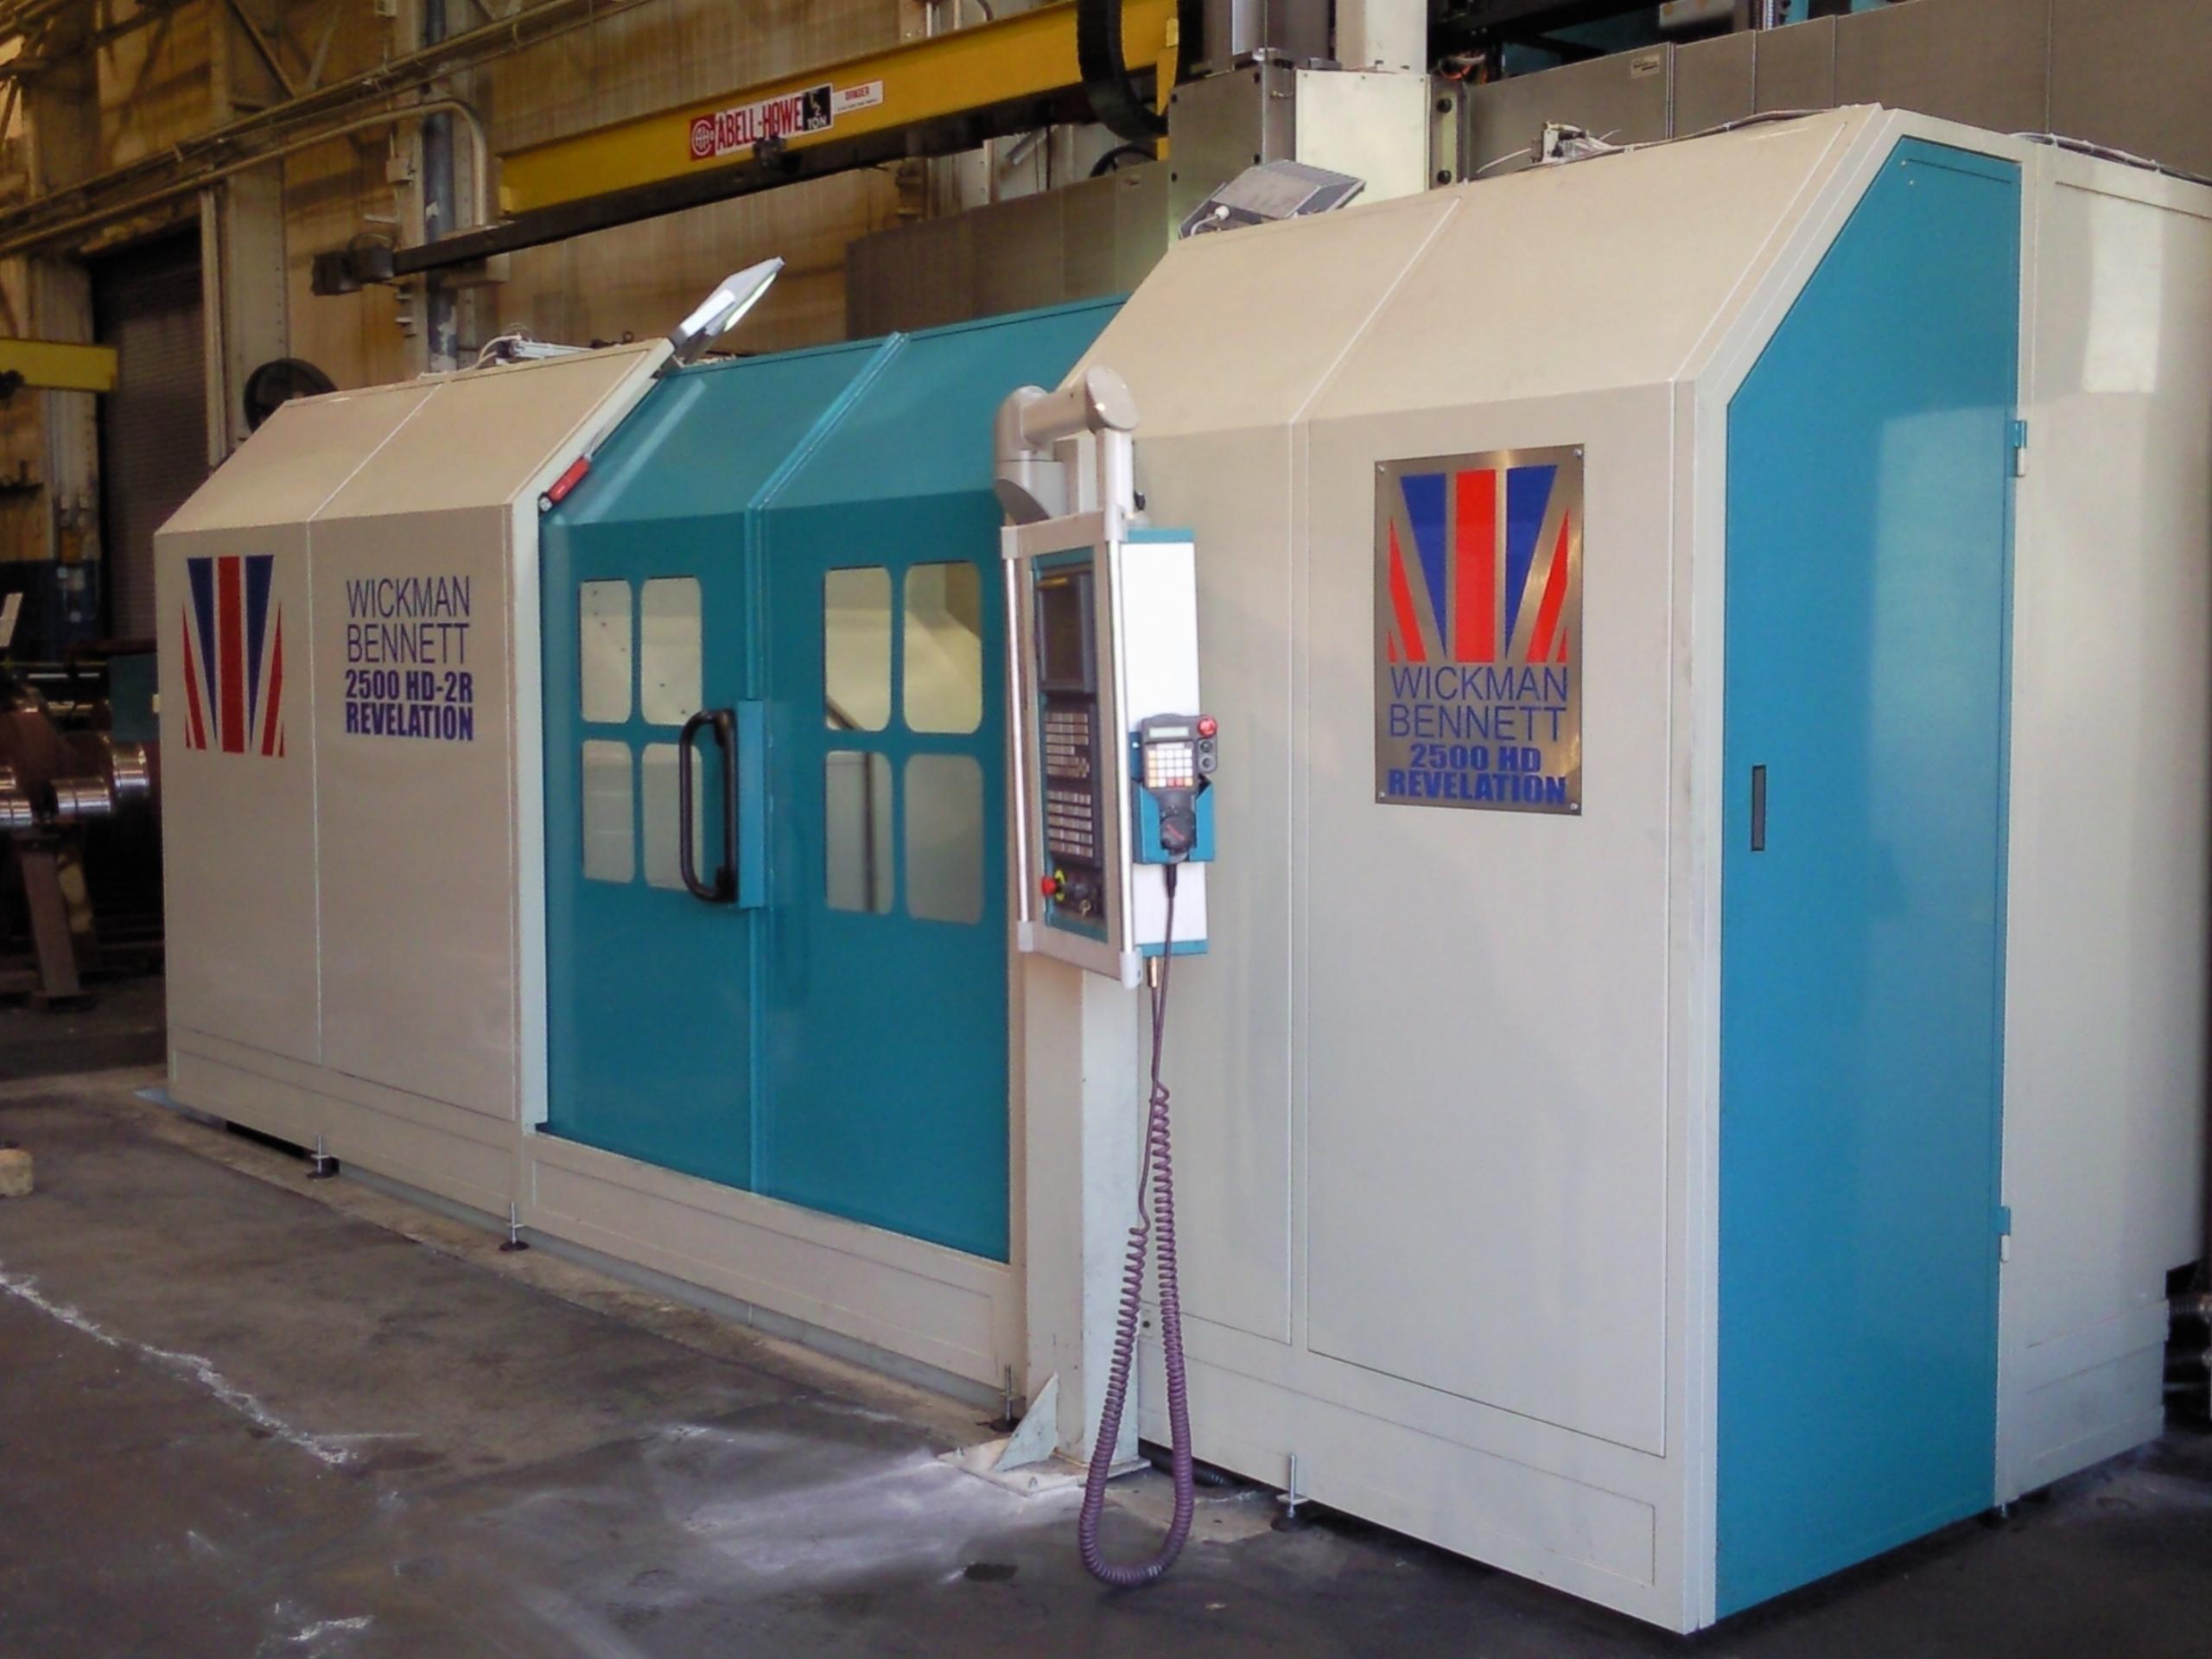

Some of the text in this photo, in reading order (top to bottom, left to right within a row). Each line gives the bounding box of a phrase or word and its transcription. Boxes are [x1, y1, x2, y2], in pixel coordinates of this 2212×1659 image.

[716, 97, 803, 151] ABELL-HOWE
[807, 116, 827, 130] TON
[346, 575, 469, 618] WICKMAN
[347, 623, 469, 664] BENNETT
[346, 669, 473, 702] 2500 HD-2R
[1390, 666, 1567, 702] WICKMAN
[346, 702, 473, 741] REVELATION
[1389, 703, 1567, 741] BENNETT
[1410, 743, 1541, 772] 2500 HD
[1389, 768, 1567, 804] REVELATION
